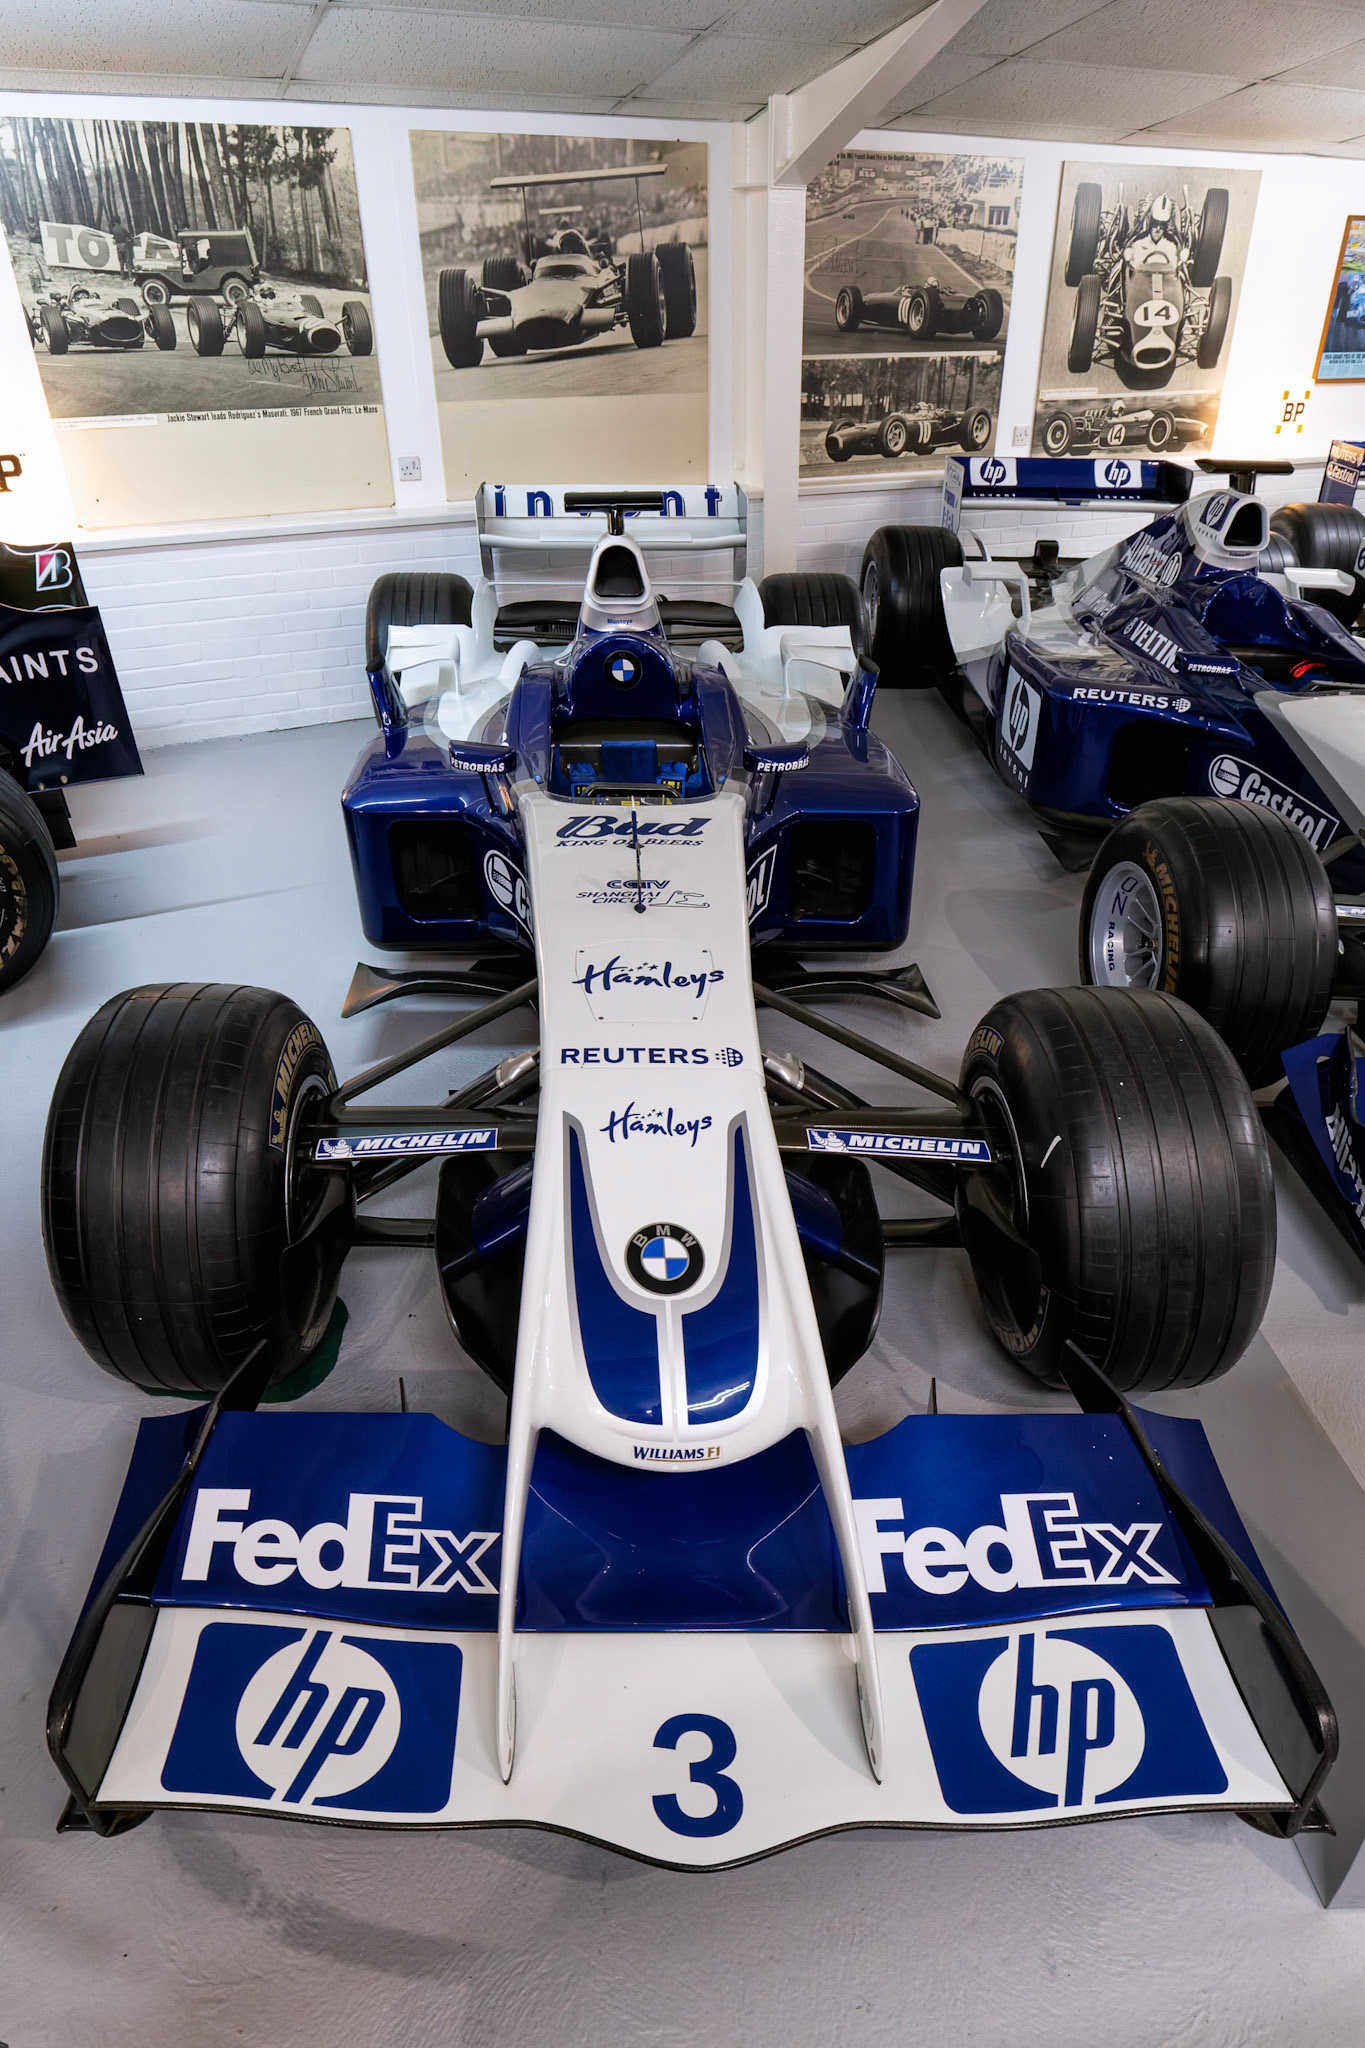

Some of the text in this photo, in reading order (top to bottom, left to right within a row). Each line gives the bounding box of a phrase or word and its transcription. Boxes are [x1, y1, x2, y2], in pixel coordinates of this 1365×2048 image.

[1142, 305, 1172, 323] 14
[167, 414, 185, 423] Jackie
[187, 413, 210, 422] Stewart
[211, 412, 227, 421] leads
[228, 411, 261, 421] Rodriguez's
[290, 408, 302, 417] 1967
[304, 408, 323, 416] French
[324, 407, 340, 415] Grand
[355, 406, 362, 414] Le
[363, 405, 378, 414] Mans
[1282, 402, 1305, 422] BP
[1109, 426, 1123, 443] 14
[983, 458, 1003, 486] hp
[1108, 459, 1128, 488] hp
[1332, 465, 1356, 484] Castrol
[494, 485, 722, 517] innt
[1206, 494, 1230, 527] hp
[1120, 531, 1166, 582] Allianz
[1188, 663, 1233, 675] PETROBRAS
[1073, 687, 1169, 710] REUTERS
[1010, 677, 1029, 752] hp
[451, 757, 505, 773] PETROBRAS
[757, 756, 810, 773] PETROBRAS
[1000, 739, 1029, 789] invent
[556, 816, 712, 838] Bud
[554, 839, 607, 847] KING
[643, 838, 703, 847] BEERS
[1107, 921, 1116, 972] RACING
[572, 956, 725, 999] Hamleys
[277, 1023, 323, 1105] MICHELIN
[560, 1047, 709, 1065] REUTERS
[600, 1102, 712, 1147] Hamleys
[355, 1131, 491, 1151] MICHELIN
[849, 1134, 981, 1155] MICHELIN
[632, 1224, 697, 1248] BMW
[633, 1445, 721, 1460] WILLIAMS F1
[181, 1488, 502, 1595] FedEx
[852, 1492, 1181, 1595] FedEx
[253, 1630, 386, 1803] hp
[1010, 1633, 1116, 1807] hp
[652, 1713, 744, 1838] 3
